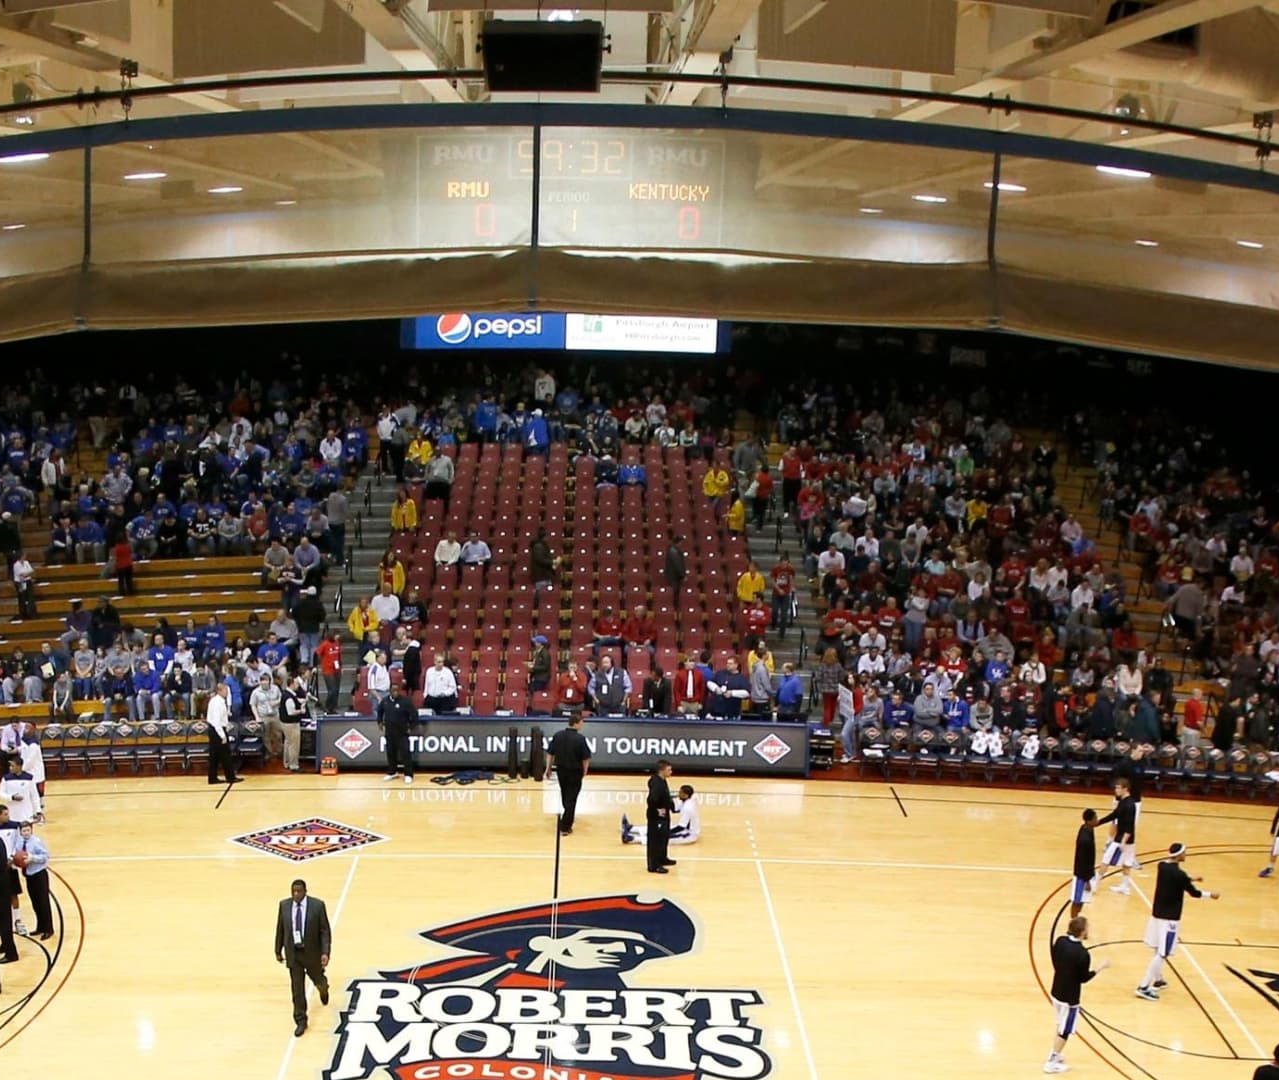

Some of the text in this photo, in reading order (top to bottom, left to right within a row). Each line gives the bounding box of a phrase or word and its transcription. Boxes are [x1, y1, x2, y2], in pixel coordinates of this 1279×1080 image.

[433, 144, 494, 165] RMU
[647, 147, 709, 166] RMU
[447, 181, 490, 199] RMU
[629, 183, 710, 201] KENTUCKY
[474, 204, 496, 236] 0
[680, 206, 701, 239] 0
[474, 315, 542, 338] pepsi
[380, 735, 481, 753] TIONAL
[604, 737, 747, 757] TOURNAMENT
[269, 834, 352, 845] NIT
[349, 980, 760, 1026] ROBERT
